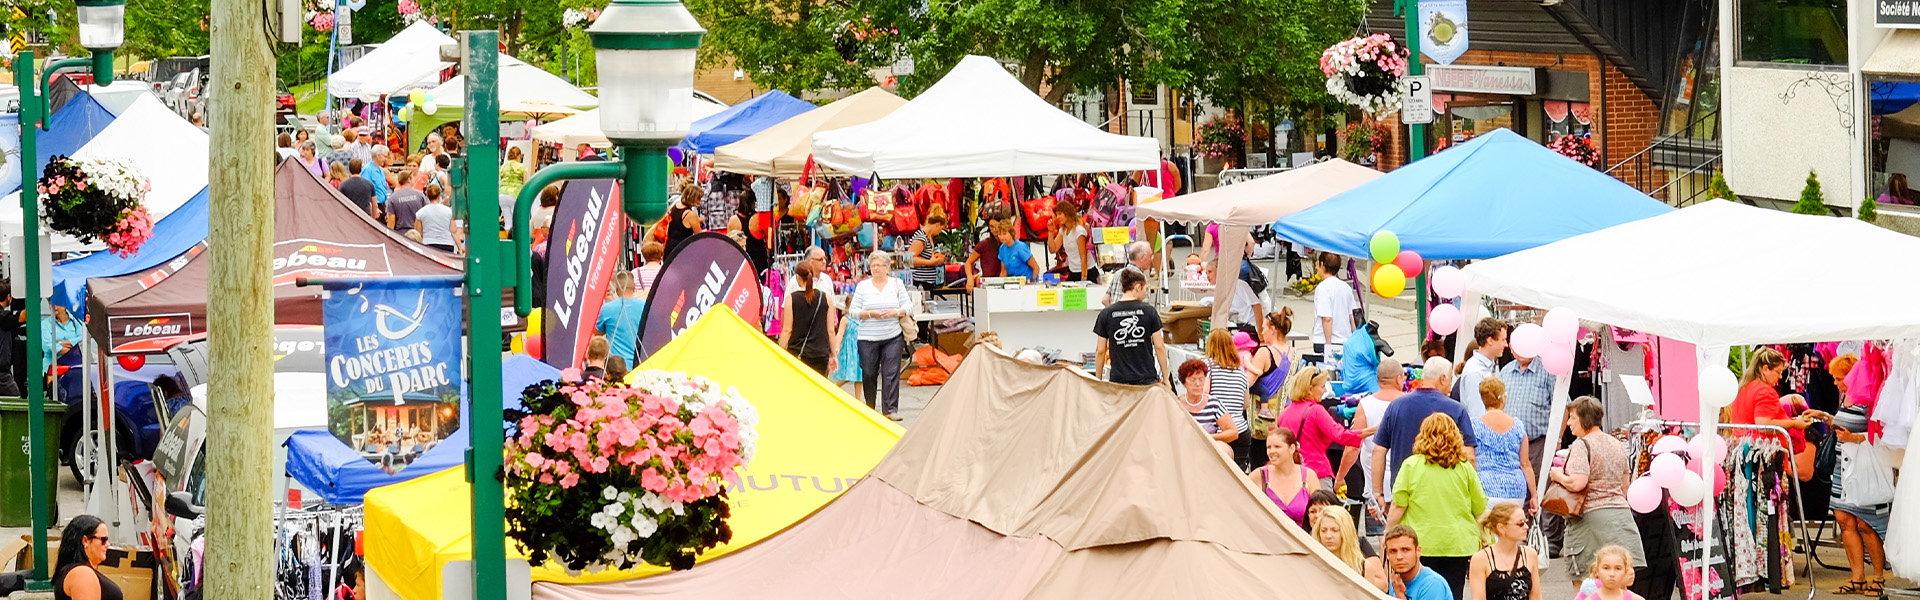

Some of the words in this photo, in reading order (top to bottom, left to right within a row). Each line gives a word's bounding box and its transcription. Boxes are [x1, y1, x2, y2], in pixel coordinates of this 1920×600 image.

[1880, 1, 1910, 16] Société
[1410, 81, 1422, 97] P
[1434, 68, 1473, 88] INGERIE
[1473, 69, 1531, 90] Vanessa
[274, 250, 366, 270] ebeau
[553, 186, 603, 330] Lebeau
[588, 255, 604, 291] Vitres
[601, 210, 619, 254] d'autos
[670, 260, 727, 341] eau
[732, 287, 750, 315] utos
[124, 323, 181, 337] Lebeau
[355, 333, 379, 353] LES
[330, 340, 432, 388] CONCERTS
[365, 376, 384, 394] DU
[388, 361, 450, 406] PARC
